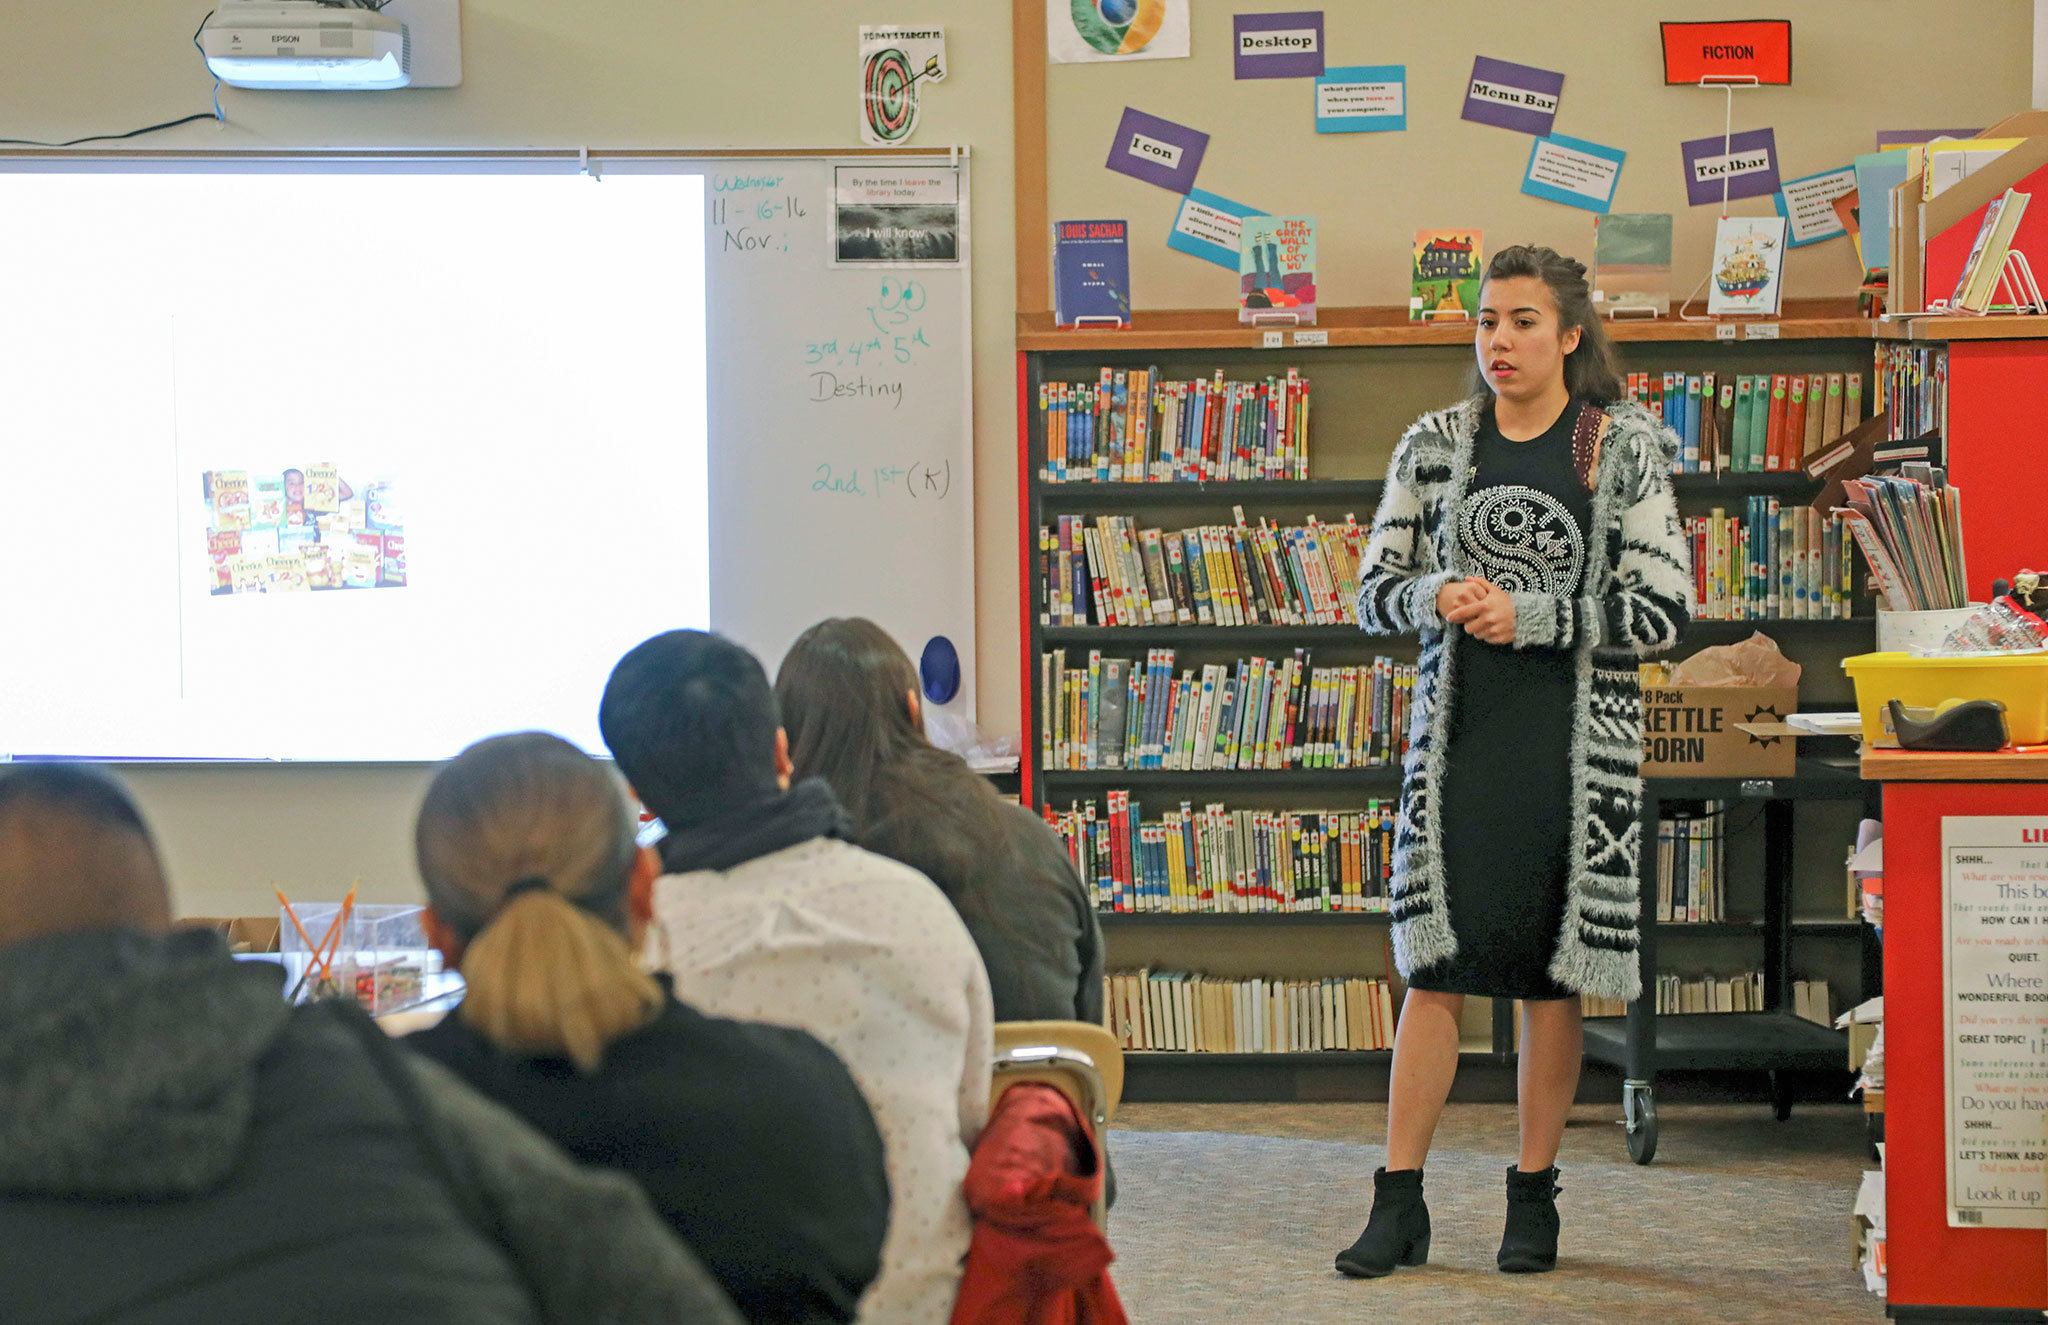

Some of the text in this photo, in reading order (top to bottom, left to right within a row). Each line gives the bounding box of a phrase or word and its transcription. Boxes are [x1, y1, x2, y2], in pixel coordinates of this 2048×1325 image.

[272, 35, 300, 43] EPSON
[863, 32, 898, 40] TODAY'S
[900, 31, 931, 39] TARGET
[1242, 36, 1312, 49] Desktop
[1702, 46, 1755, 60] FICTION
[1473, 83, 1556, 110] Menu Bar
[1697, 156, 1767, 178] Toolbar
[853, 179, 863, 188] By
[866, 179, 878, 187] the
[880, 179, 898, 187] time
[904, 179, 927, 188] leave
[928, 179, 942, 187] the
[867, 189, 891, 198] library
[1196, 206, 1214, 218] little
[1189, 217, 1213, 228] allows
[1214, 225, 1228, 233] you
[1284, 220, 1306, 229] THE
[873, 227, 893, 239] will
[1061, 224, 1088, 239] LOUIS
[1276, 229, 1312, 238] GREAT
[1192, 229, 1228, 246] program.
[1280, 238, 1309, 246] WALL
[1286, 245, 1300, 254] OF
[1280, 254, 1309, 263] LUCY
[1286, 262, 1302, 271] WU
[810, 371, 903, 411] Destiny
[1655, 690, 1684, 705] Pack
[1643, 707, 1724, 733] KETTLE
[1643, 736, 1705, 763] CORN
[1955, 855, 1994, 865] SHHH...
[1962, 872, 1985, 881] What
[1996, 883, 2029, 899] This
[1981, 916, 2006, 925] HOW
[2010, 916, 2030, 925] CAN
[2008, 952, 2041, 963] QUIET.
[1987, 972, 2043, 989] Where
[1957, 992, 2020, 1002] WONDERFUL
[1959, 1034, 2027, 1044] GREAT TOPIC!
[1962, 1096, 1986, 1111] Do
[1988, 1100, 2018, 1115] you
[1959, 1150, 1986, 1161] LET'S
[1989, 1151, 2019, 1161] THINK
[1967, 1186, 2042, 1205] Look it up
